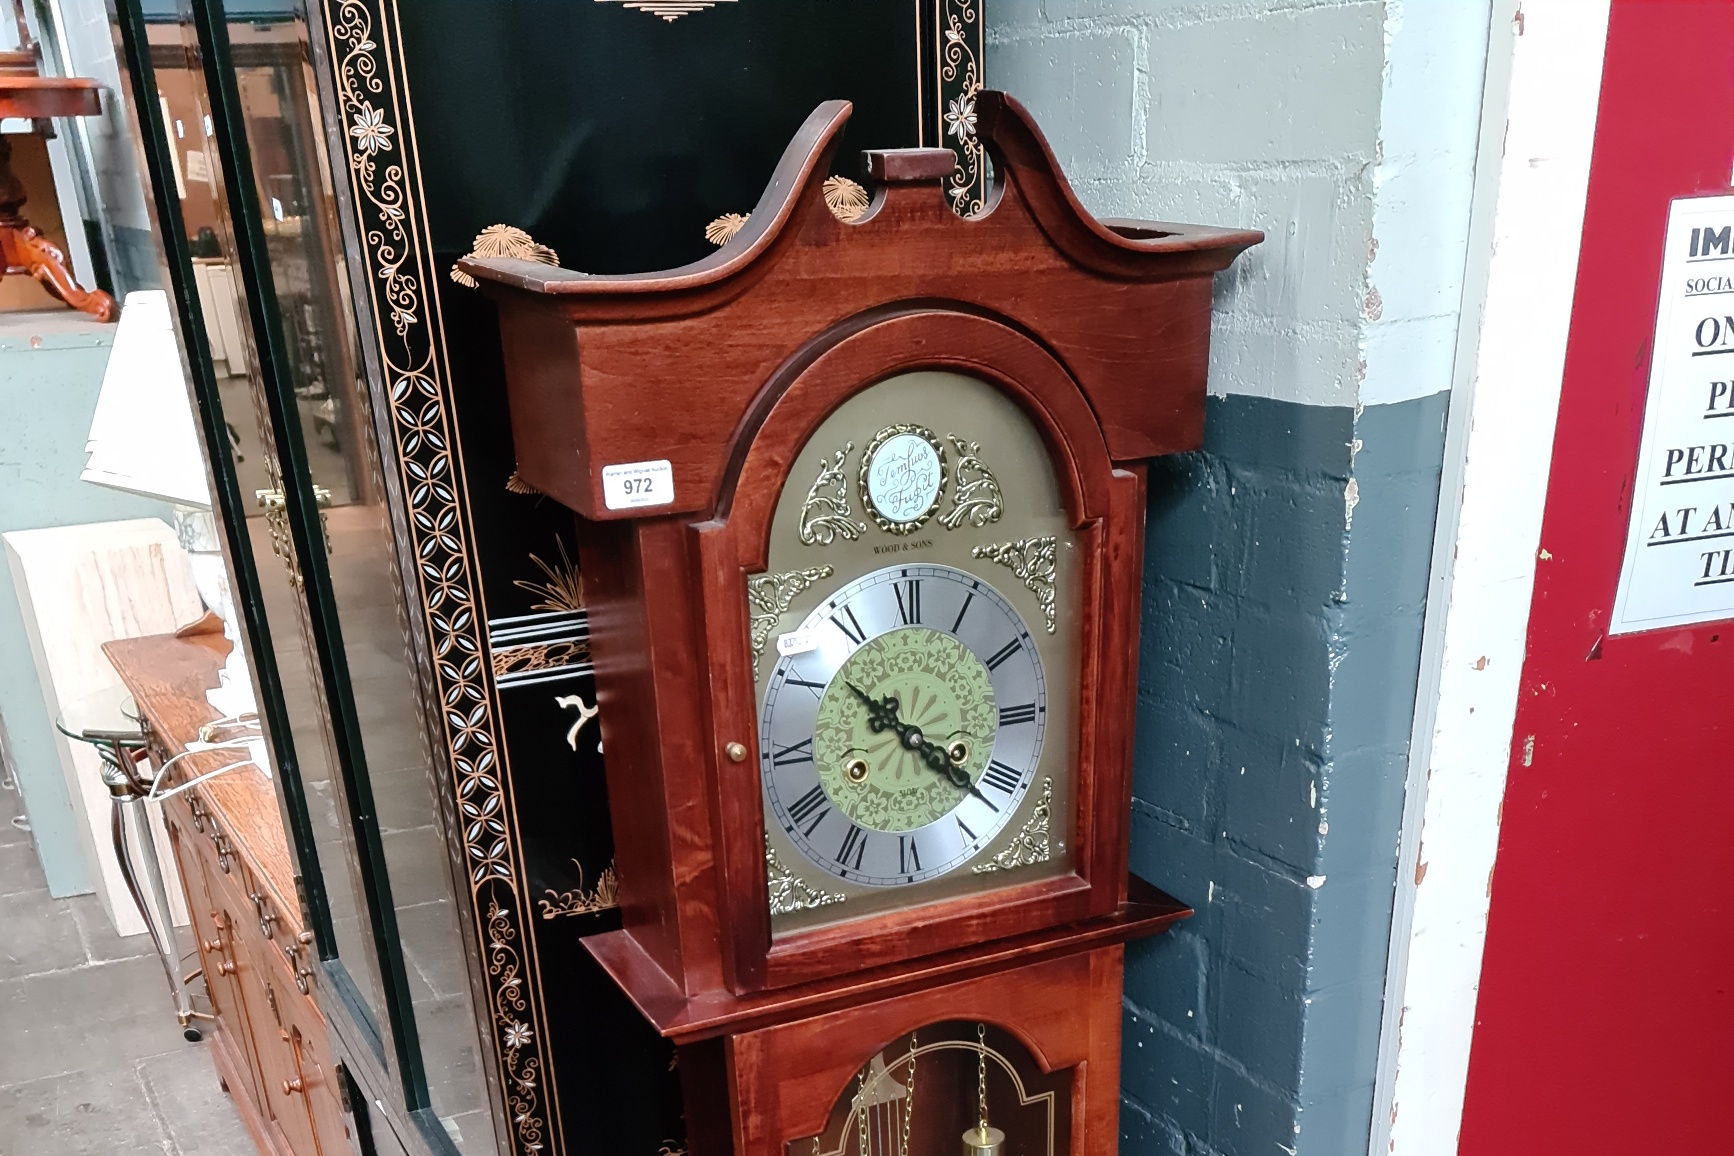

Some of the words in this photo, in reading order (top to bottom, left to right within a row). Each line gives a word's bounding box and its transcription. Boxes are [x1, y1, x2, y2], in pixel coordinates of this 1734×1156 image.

[1689, 226, 1734, 257] IM
[1686, 276, 1734, 293] SOCIA
[877, 440, 930, 486] Tempus
[1662, 442, 1734, 478] PER
[624, 478, 653, 495] 972
[887, 472, 935, 516] Fugit
[1649, 507, 1698, 540] AT
[873, 544, 900, 554] WOOD
[902, 543, 909, 551] &
[911, 539, 933, 550] SONS
[1700, 548, 1734, 578] TI
[889, 579, 924, 628] XII
[948, 590, 976, 635] I
[813, 601, 871, 653] XI
[983, 634, 1024, 675] II
[998, 699, 1036, 729] III
[786, 782, 832, 840] VIII
[834, 823, 868, 870] VII
[897, 835, 924, 874] VI
